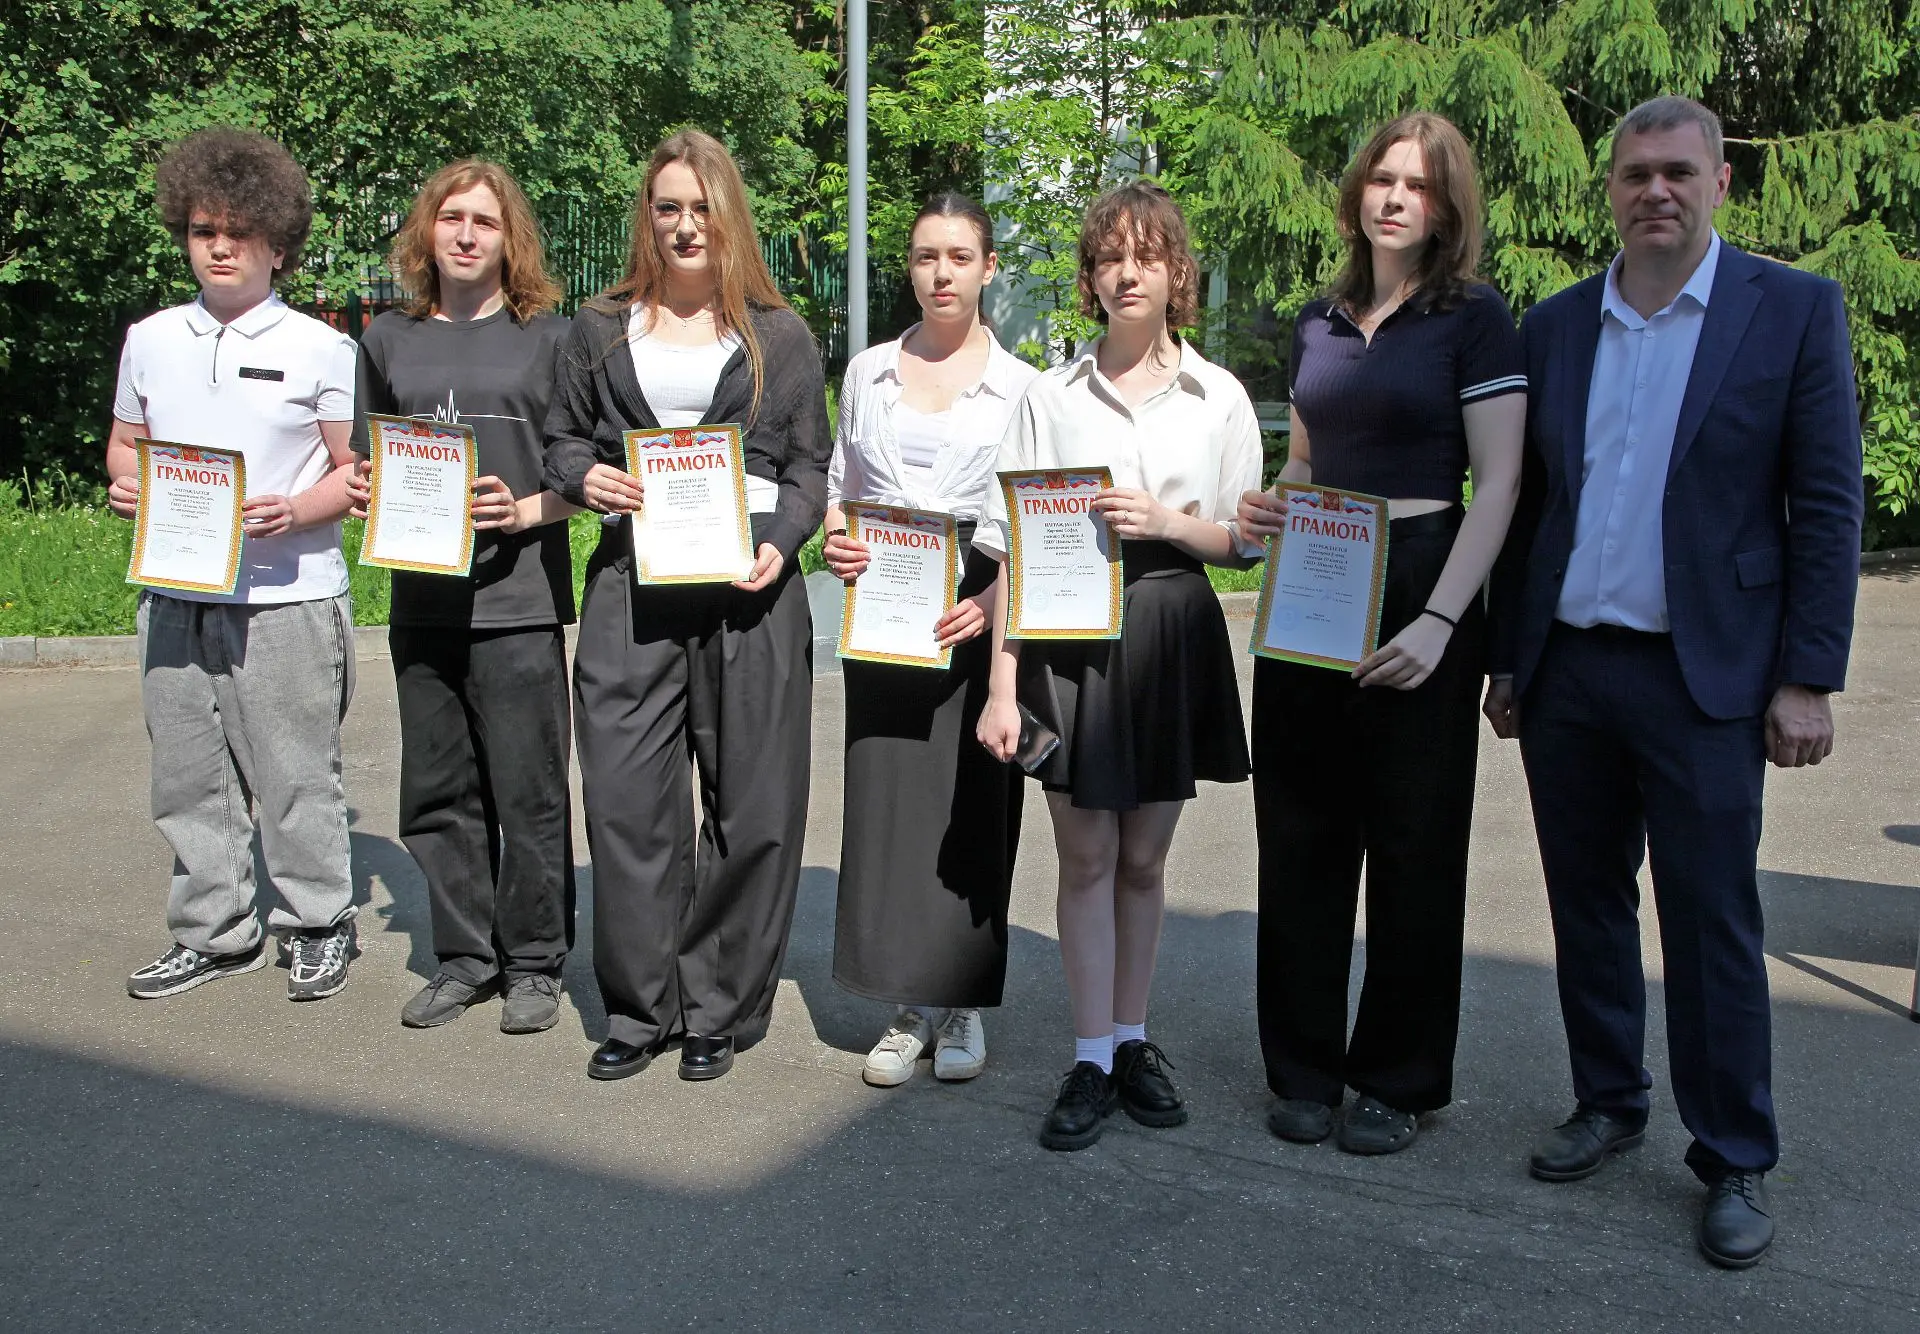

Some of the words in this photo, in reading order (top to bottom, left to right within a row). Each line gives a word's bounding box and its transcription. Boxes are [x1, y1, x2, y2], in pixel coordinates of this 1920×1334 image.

[389, 442, 461, 462] ГРАМОТА
[647, 454, 726, 473] ГРАМОТА
[157, 466, 229, 487] ГРАМОТА
[865, 528, 940, 550] ГРАМОТА
[1292, 516, 1369, 542] ГРАМОТА
